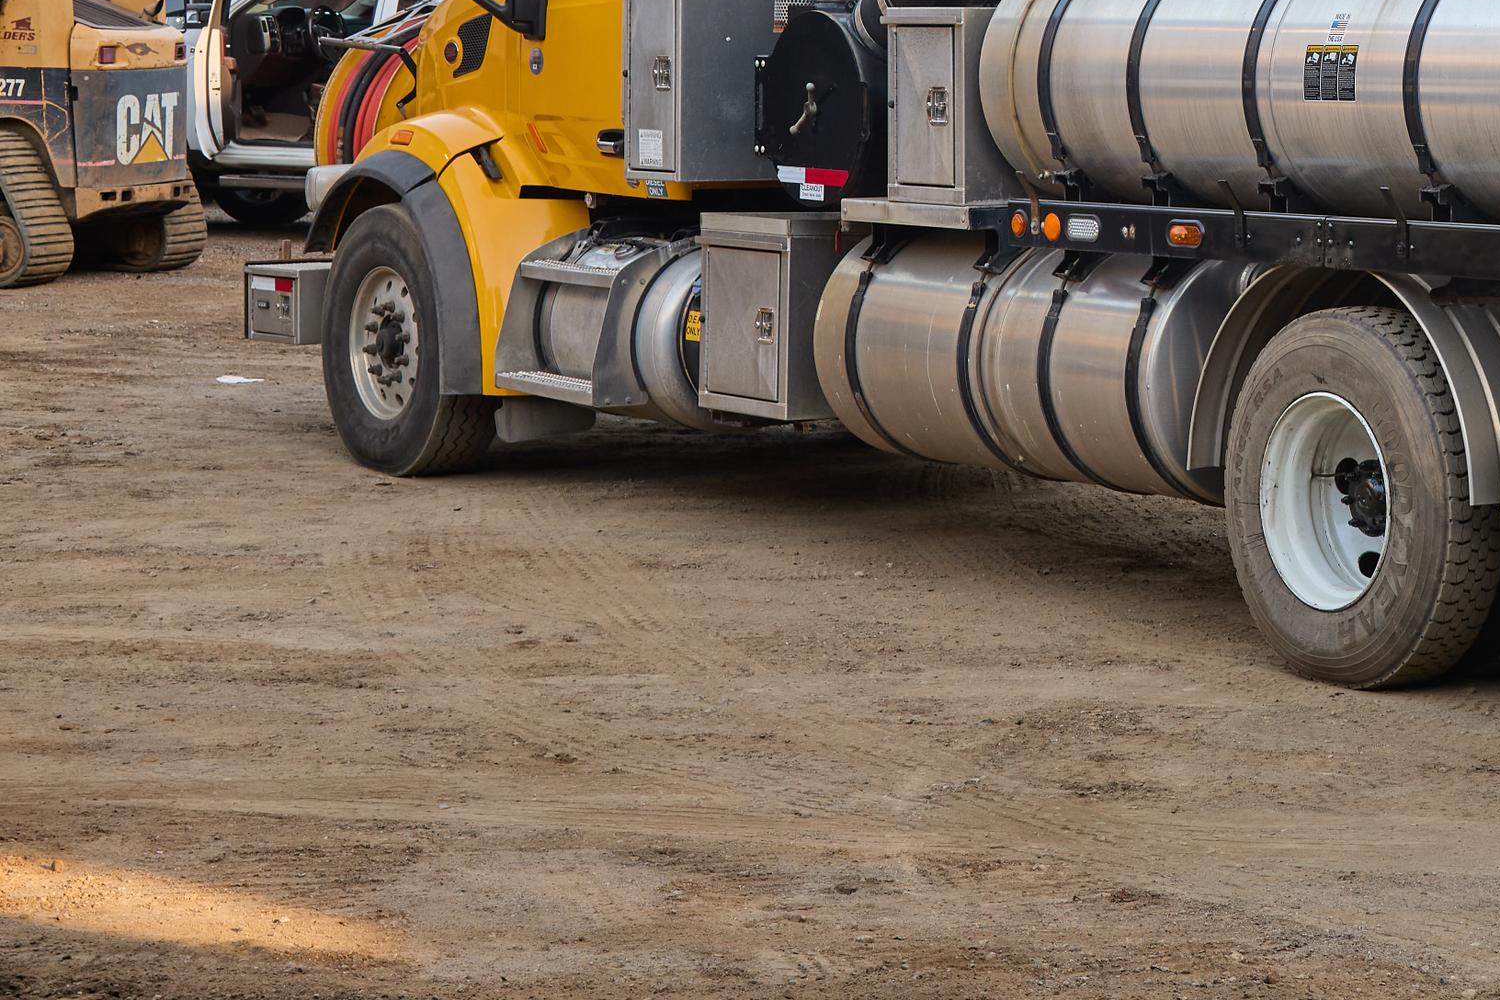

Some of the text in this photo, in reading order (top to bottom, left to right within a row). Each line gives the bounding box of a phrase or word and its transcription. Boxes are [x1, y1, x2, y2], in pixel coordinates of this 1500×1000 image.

[0, 31, 36, 41] DERS
[116, 91, 180, 166] CAT
[648, 186, 664, 196] ONLY
[687, 326, 701, 336] ONLY
[1335, 400, 1415, 647] GOODYEAR
